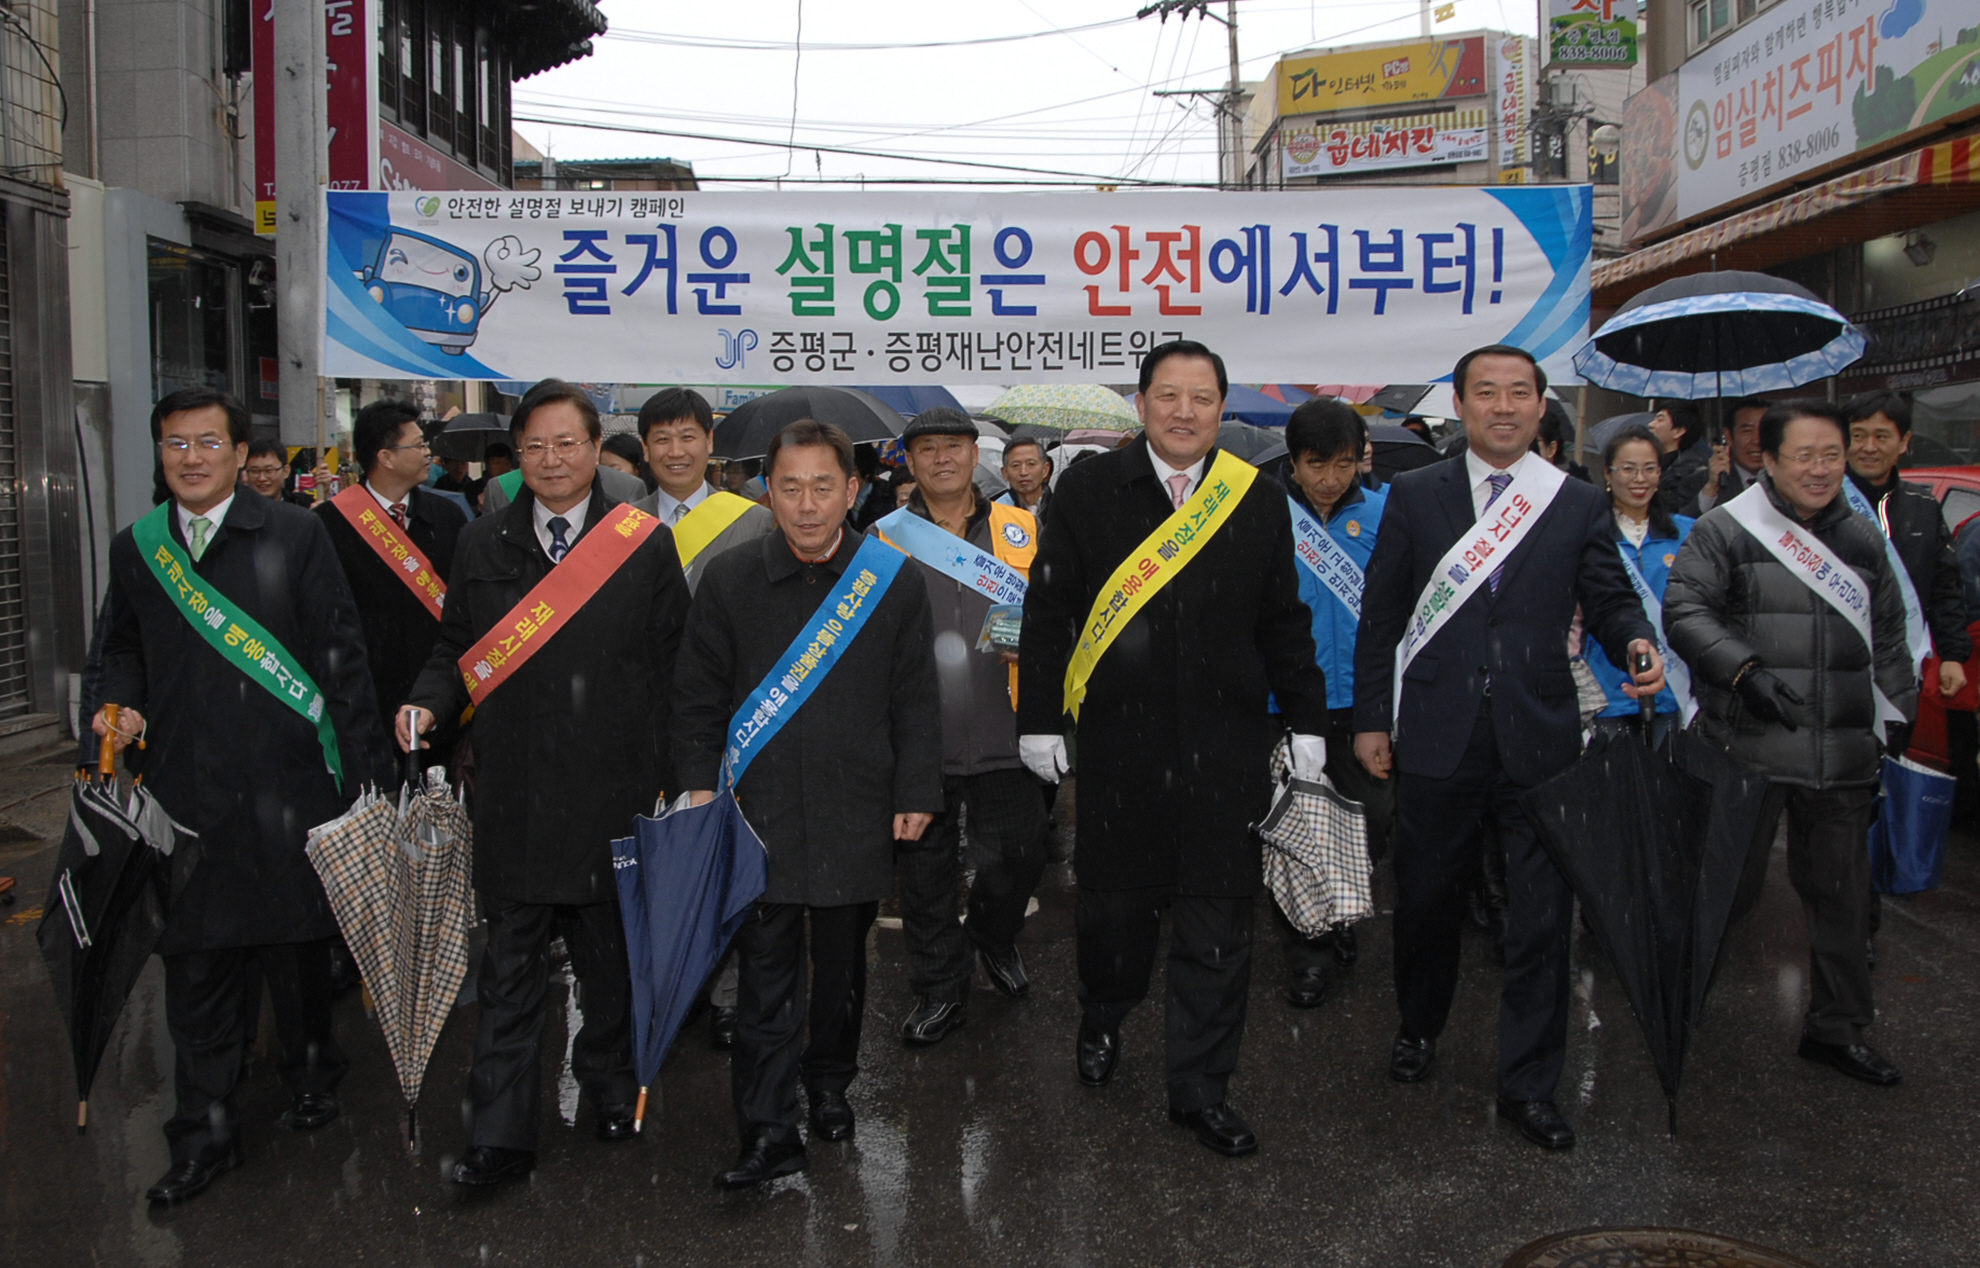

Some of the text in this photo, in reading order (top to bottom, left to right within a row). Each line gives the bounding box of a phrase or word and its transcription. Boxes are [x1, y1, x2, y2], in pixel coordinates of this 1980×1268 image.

[1559, 45, 1628, 60] 838-8006
[1713, 41, 1760, 86] 임실피자와
[1765, 12, 1807, 57] 함께하면
[1502, 72, 1517, 143] 굽네치킨
[1713, 14, 1878, 160] 임실치즈피자
[1327, 126, 1435, 166] 굽네치킨
[1738, 122, 1839, 188] 증평점 838-8006
[448, 197, 685, 219] 안전한 설명절 보내기 캠페인
[553, 223, 1504, 321] 즐거운 설명절은 안전에서부터!
[358, 508, 420, 573] 재래시장을
[614, 508, 651, 538] 증평사
[1296, 517, 1334, 554] 즐거운
[1296, 539, 1332, 574] 안전이
[973, 554, 1007, 579] 즐거운
[1091, 479, 1231, 644] 재래시장을 애용합시다
[1404, 493, 1532, 659] 에너지 절약을 생활화합시
[154, 544, 308, 700] 재래시장을 애용합시다
[473, 601, 555, 681] 재래시장을
[735, 568, 878, 748] 증평사랑 으뜸상품권을 애용합시다
